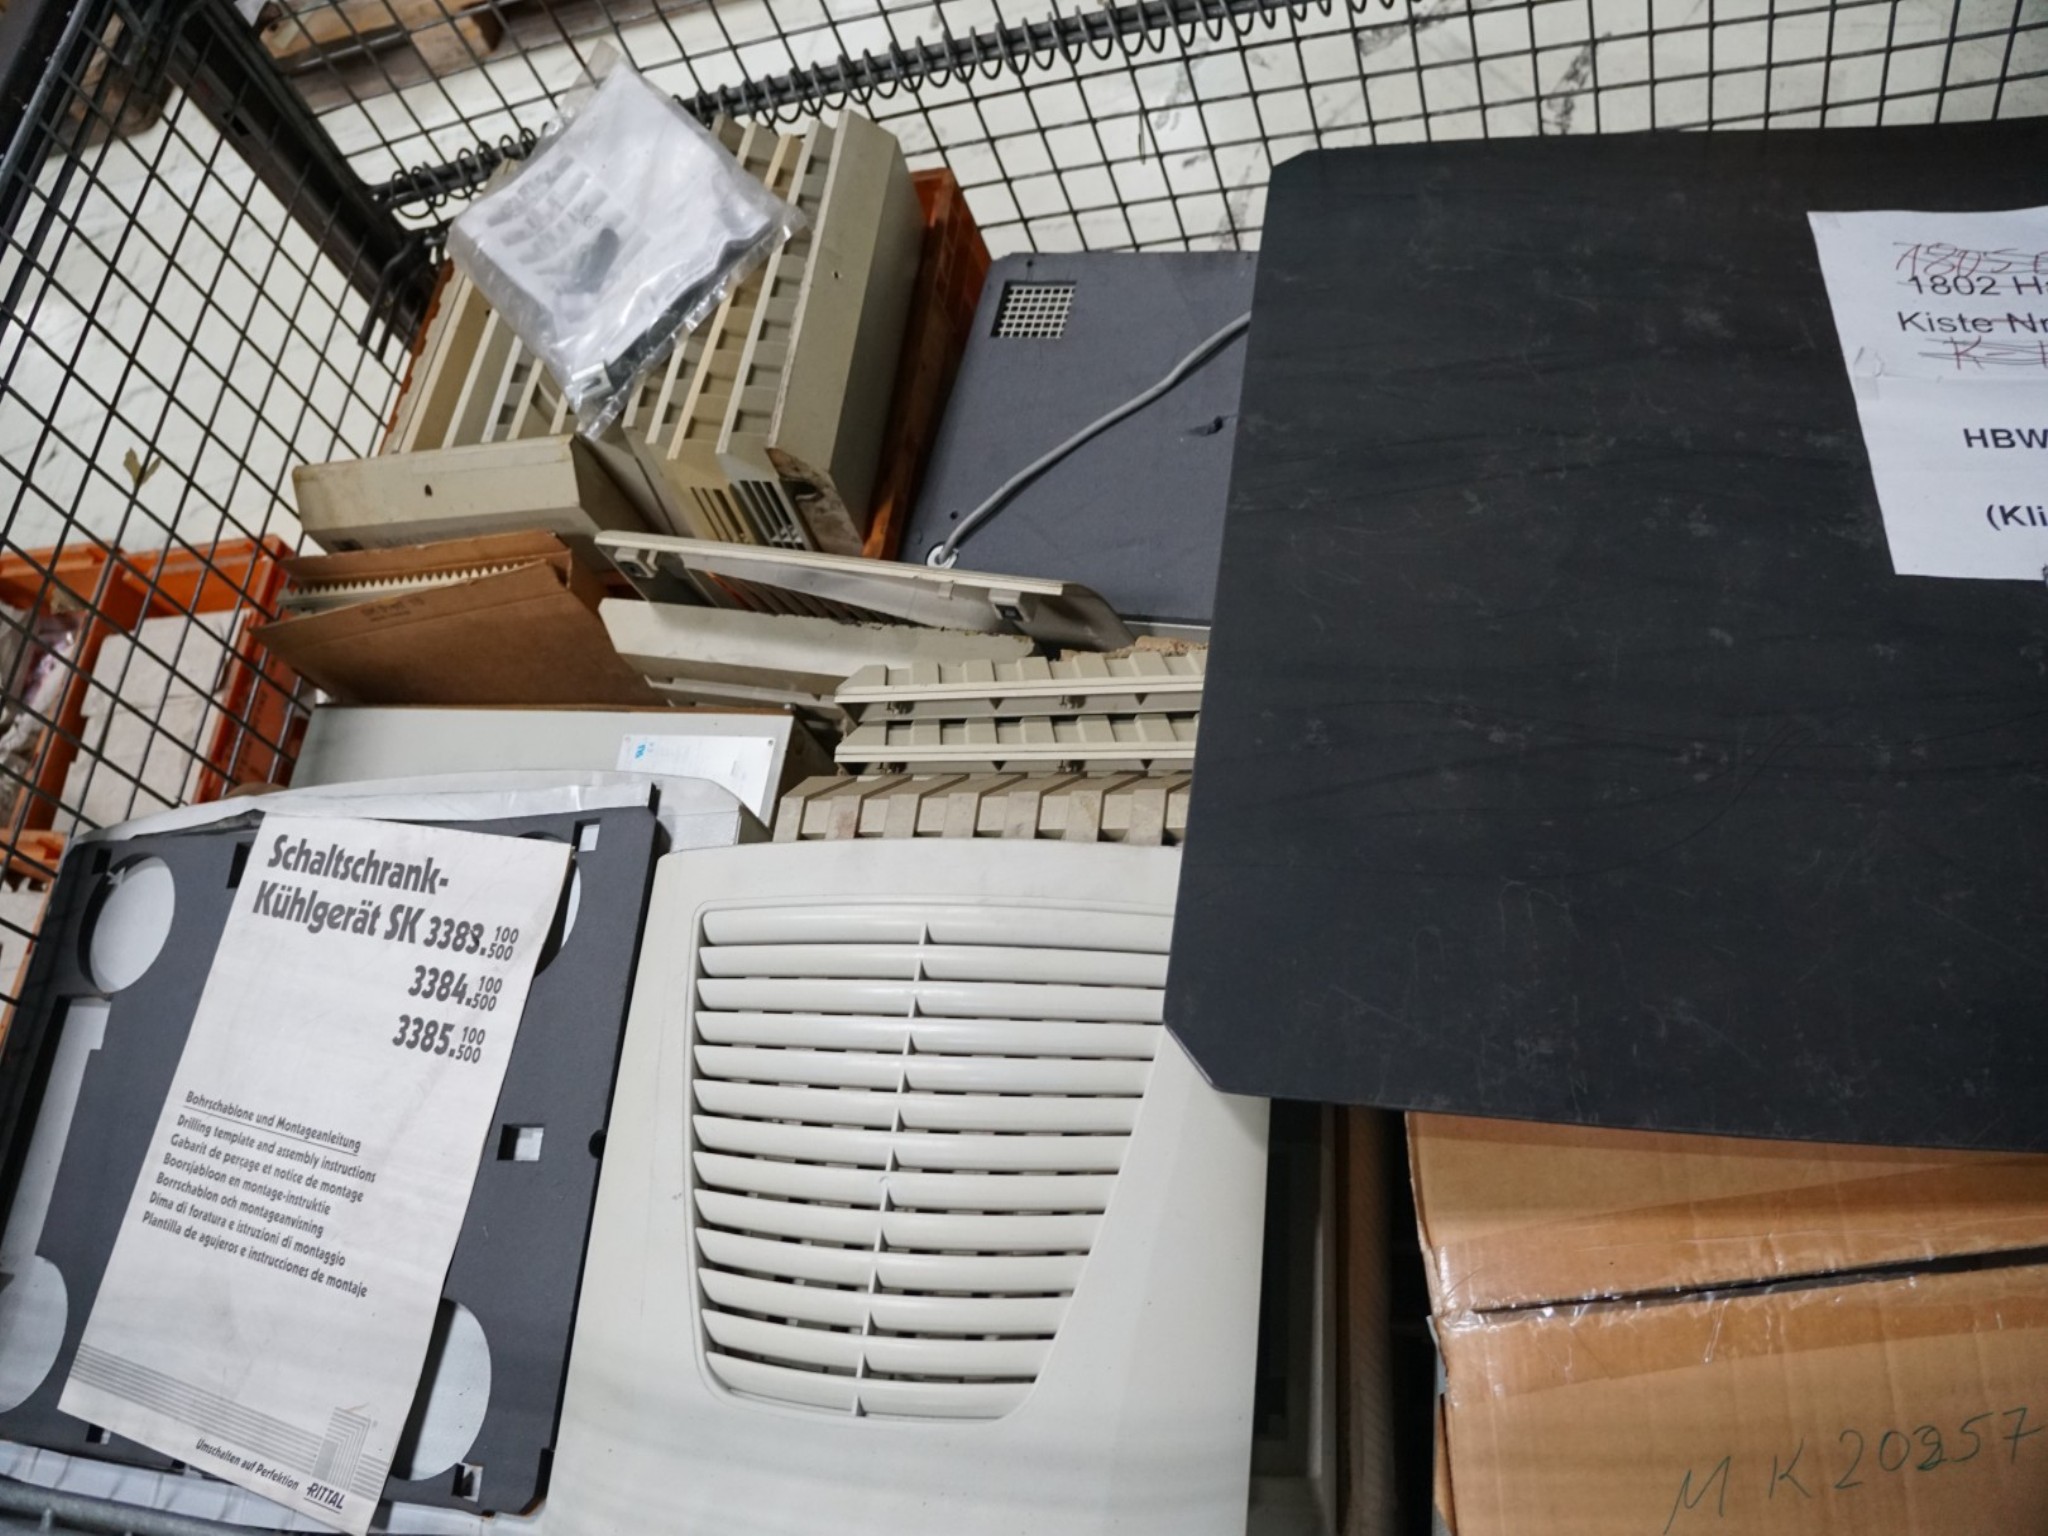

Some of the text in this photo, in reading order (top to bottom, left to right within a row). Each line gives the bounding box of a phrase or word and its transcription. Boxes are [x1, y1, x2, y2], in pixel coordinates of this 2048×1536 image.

[1907, 275, 2048, 296] 1802 H
[1897, 311, 1993, 333] Kiste
[267, 834, 449, 895] Schaltschrank-
[252, 880, 383, 936] Kühlgerät
[383, 903, 426, 944] SK
[494, 925, 520, 945] 100
[487, 942, 514, 962] 500
[470, 993, 497, 1012] 500
[477, 975, 503, 995] 100
[454, 1044, 481, 1064] 500
[461, 1025, 486, 1046] 100
[176, 1113, 377, 1183] Drilling template and assembly instructions
[185, 1090, 362, 1153] Bohrschablone und Montageanleitung
[163, 1152, 331, 1216] Boorsjabloon en montage-instruktie
[170, 1133, 208, 1155] Gabarit
[208, 1143, 223, 1160] de
[262, 1162, 273, 1175] et
[273, 1166, 303, 1184] notice
[305, 1173, 319, 1189] de
[320, 1180, 364, 1203] montage
[149, 1191, 346, 1267] Dima di foratura e istruzioni di montaggio
[156, 1171, 324, 1239] Borrschablon och montageanvisning
[141, 1210, 368, 1298] Plantilla de agujeros e instrucciones de montaje
[195, 1438, 300, 1491] Umschalten auf Perfektion
[306, 1481, 347, 1511] RITTAL
